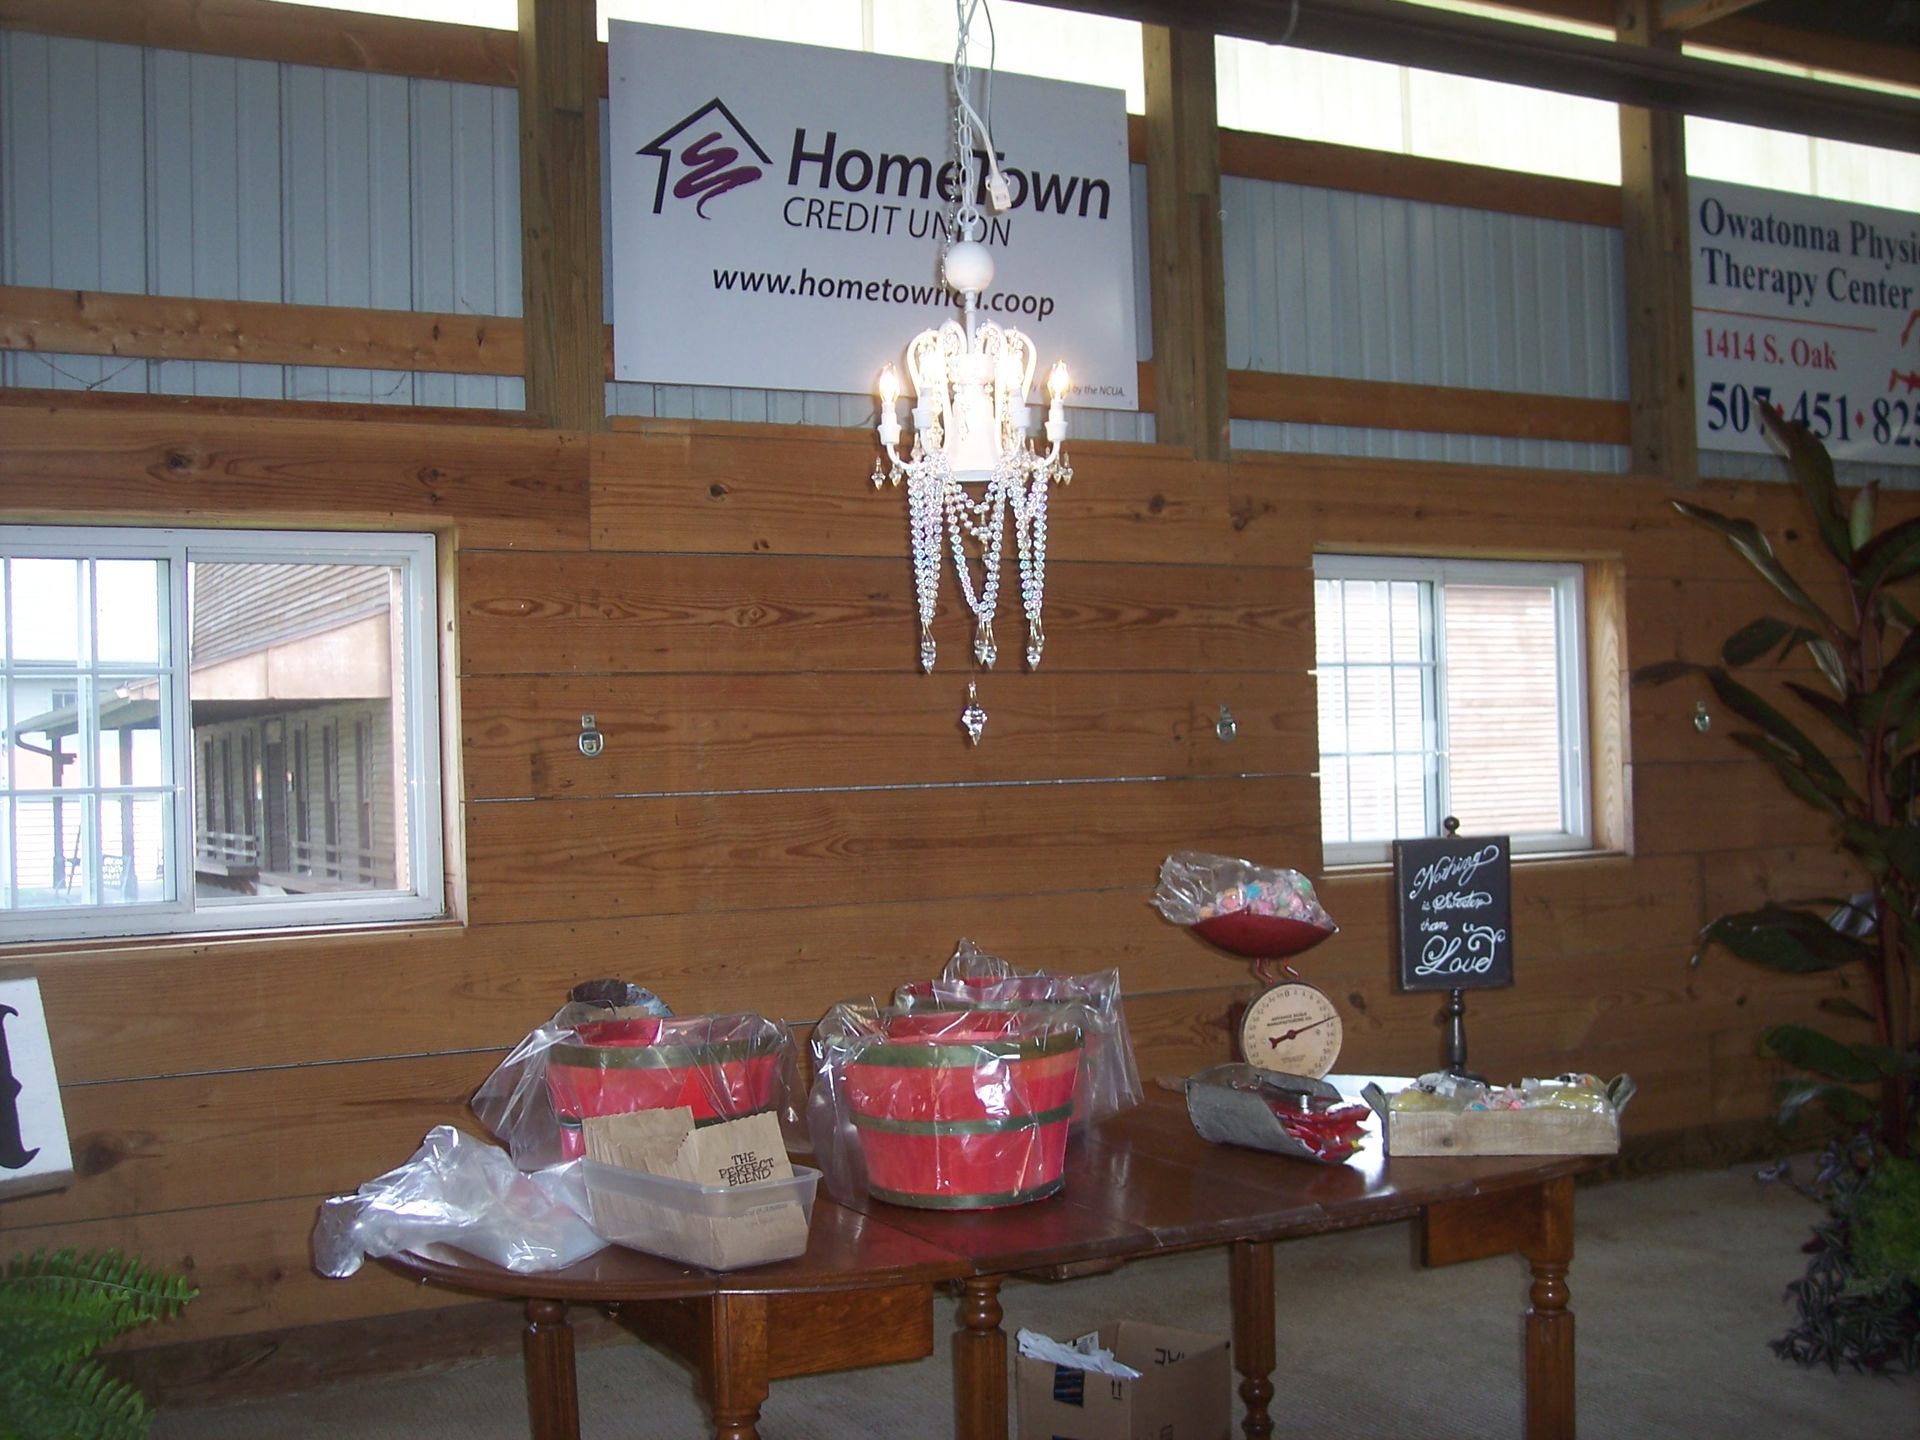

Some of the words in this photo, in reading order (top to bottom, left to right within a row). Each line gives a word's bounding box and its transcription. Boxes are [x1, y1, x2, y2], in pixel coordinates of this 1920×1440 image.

[787, 128, 1111, 220] HomeTown
[783, 196, 902, 237] CREDIT
[1700, 197, 1840, 253] Owatonna
[1849, 219, 1920, 271] Physi
[1700, 247, 1819, 307] Therapy
[1827, 267, 1914, 310] Center
[1705, 328, 1757, 361] 1414
[1764, 334, 1784, 365] S.
[1791, 338, 1838, 371] Oak
[1409, 845, 1499, 899] Nothing
[1420, 917, 1449, 932] than
[1415, 928, 1502, 975] Love
[719, 1157, 774, 1179] PERFECT
[728, 1168, 771, 1186] BLEND
[731, 1151, 756, 1165] THE
